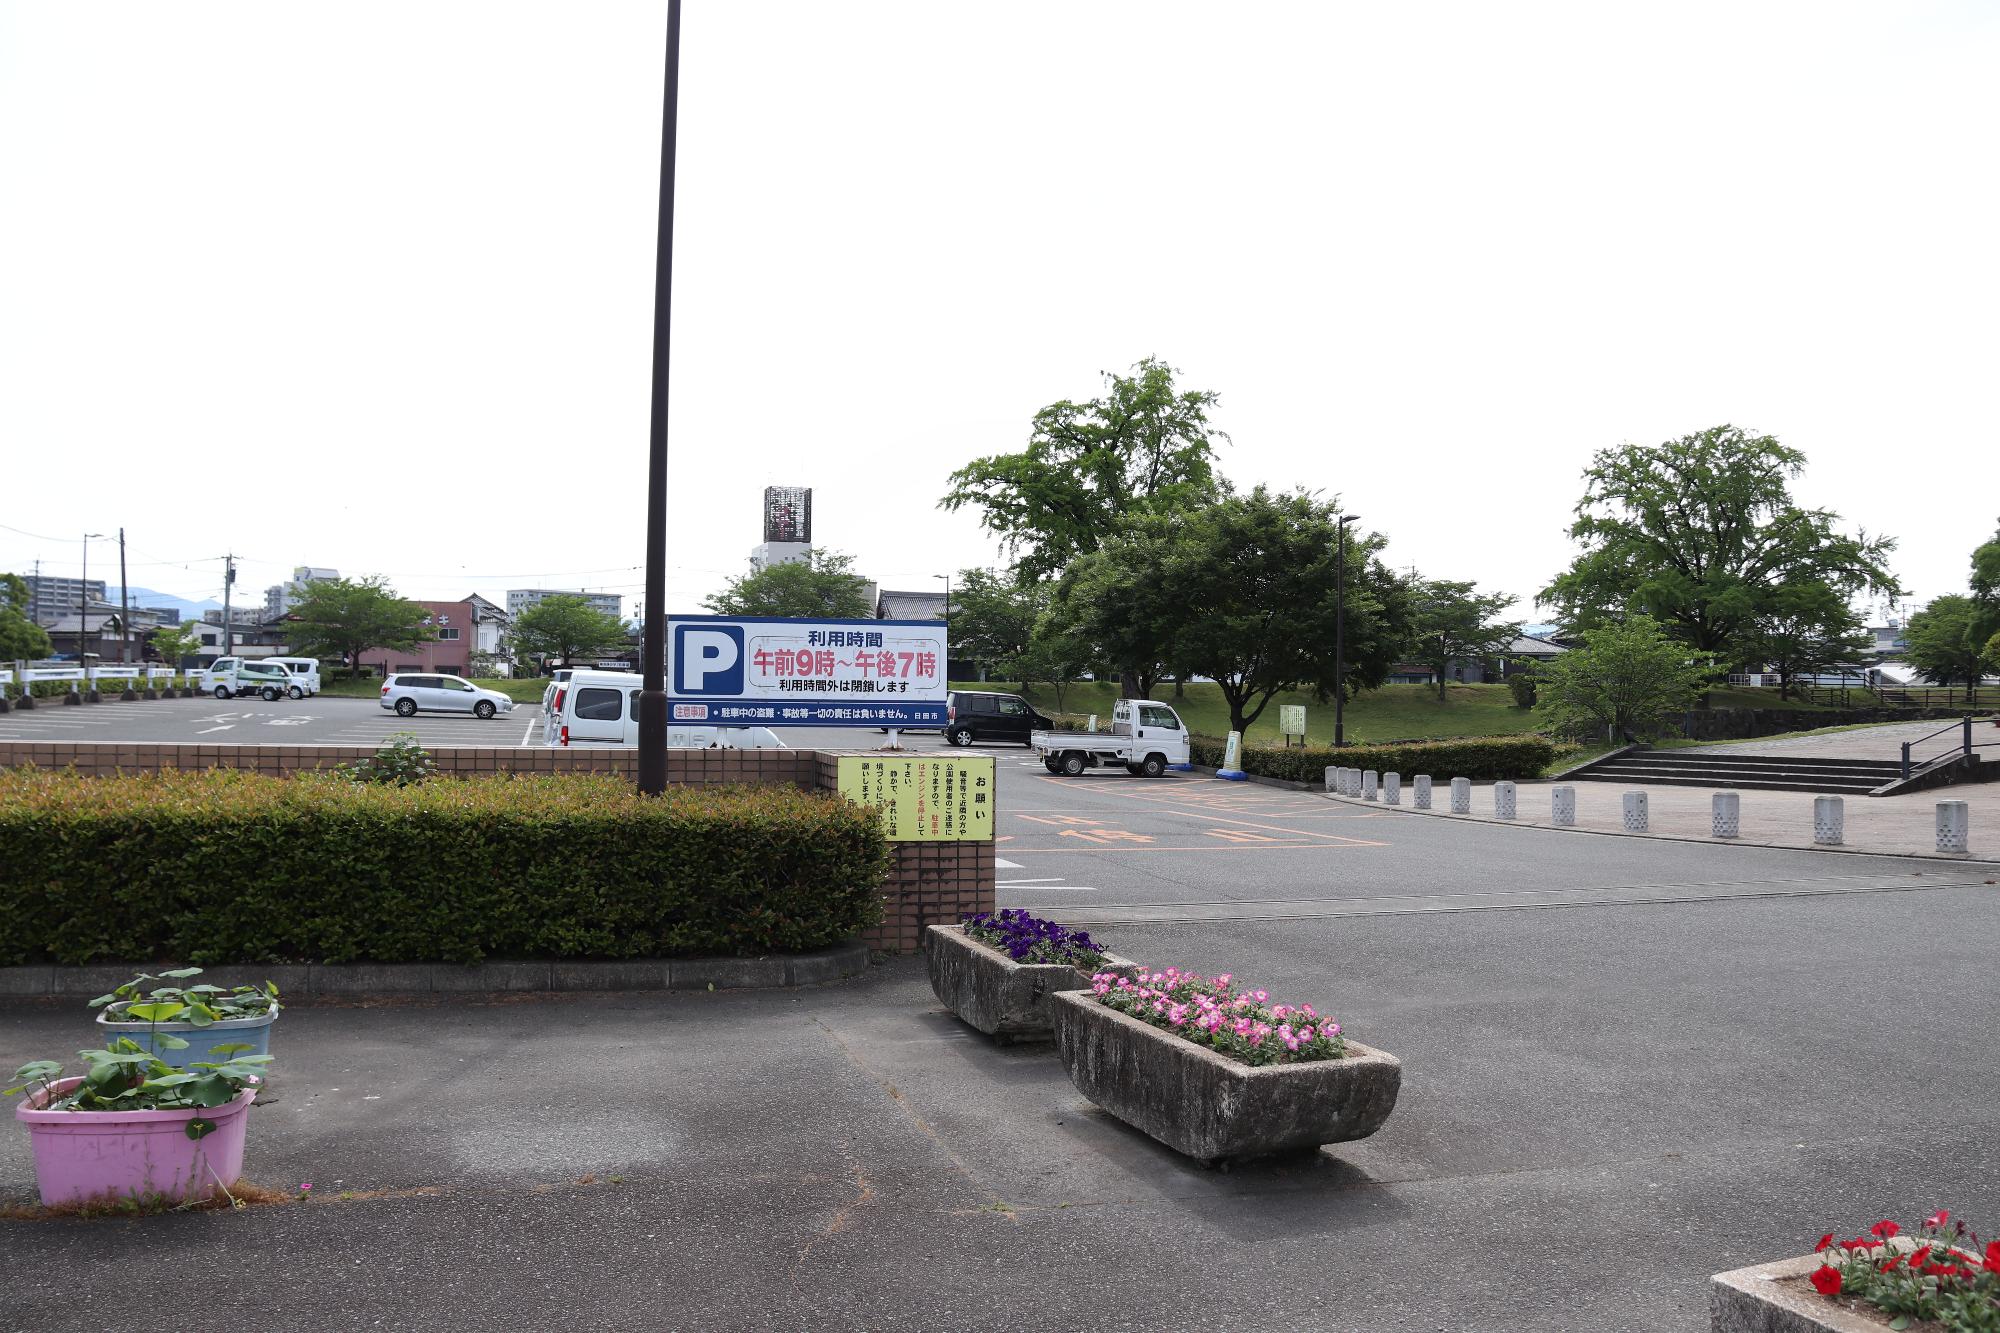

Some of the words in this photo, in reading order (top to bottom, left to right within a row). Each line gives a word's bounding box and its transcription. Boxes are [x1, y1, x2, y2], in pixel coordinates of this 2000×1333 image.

[808, 630, 883, 648] 利用時間
[683, 630, 738, 690] P
[753, 648, 936, 679] 午前9時～午後7時
[779, 679, 910, 693] 利用時間外は閉鎖します
[675, 705, 706, 718] 注意事項
[914, 712, 938, 720] 日田市
[904, 763, 912, 788] 下さい。
[917, 763, 926, 836] はエンジンを停止して
[945, 763, 953, 836] 公園使用者のご迷惑に
[959, 770, 967, 836] 騒音等で近隣の方や
[975, 776, 986, 820] お願い
